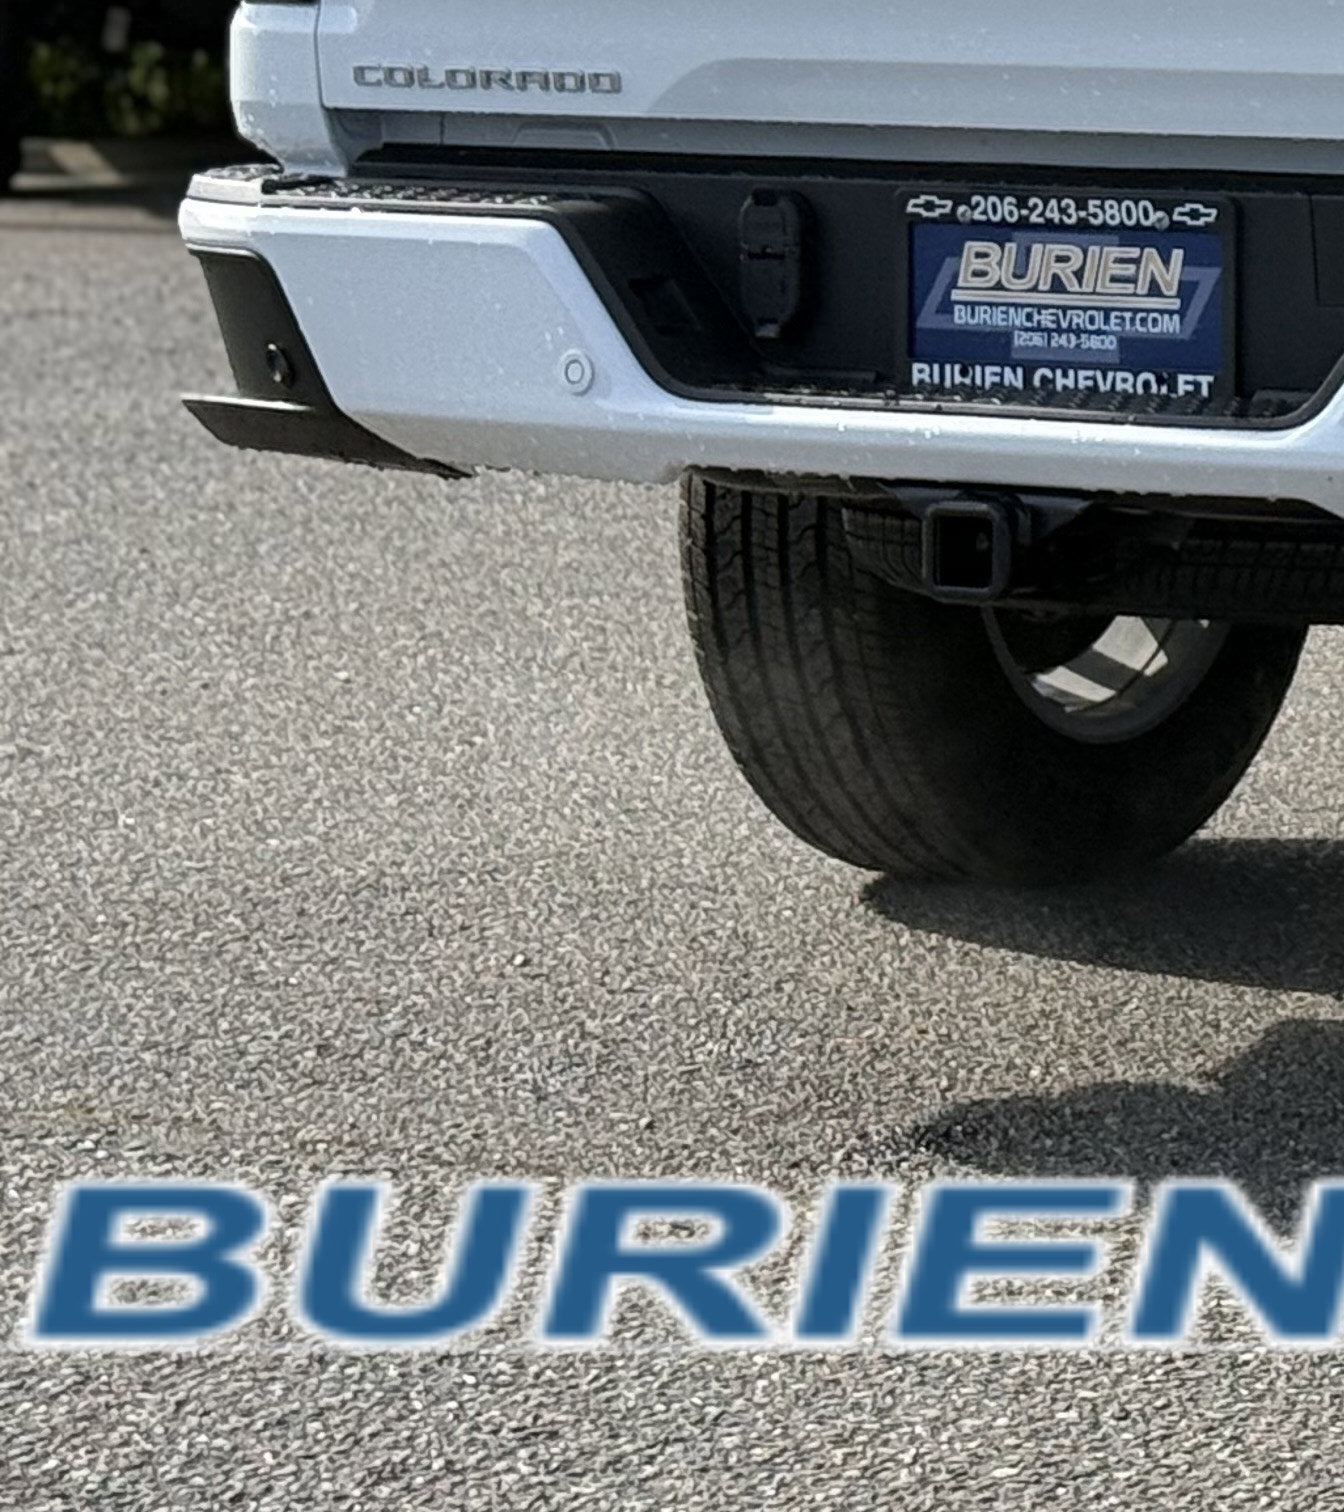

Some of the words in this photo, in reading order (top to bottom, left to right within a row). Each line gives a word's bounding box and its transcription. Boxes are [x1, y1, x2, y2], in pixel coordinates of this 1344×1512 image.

[353, 65, 624, 94] COLORADO
[970, 195, 1155, 226] 206-243-5800
[956, 240, 1184, 296] BURIEN
[953, 305, 1181, 334] BURIENCHEVROLET.COM
